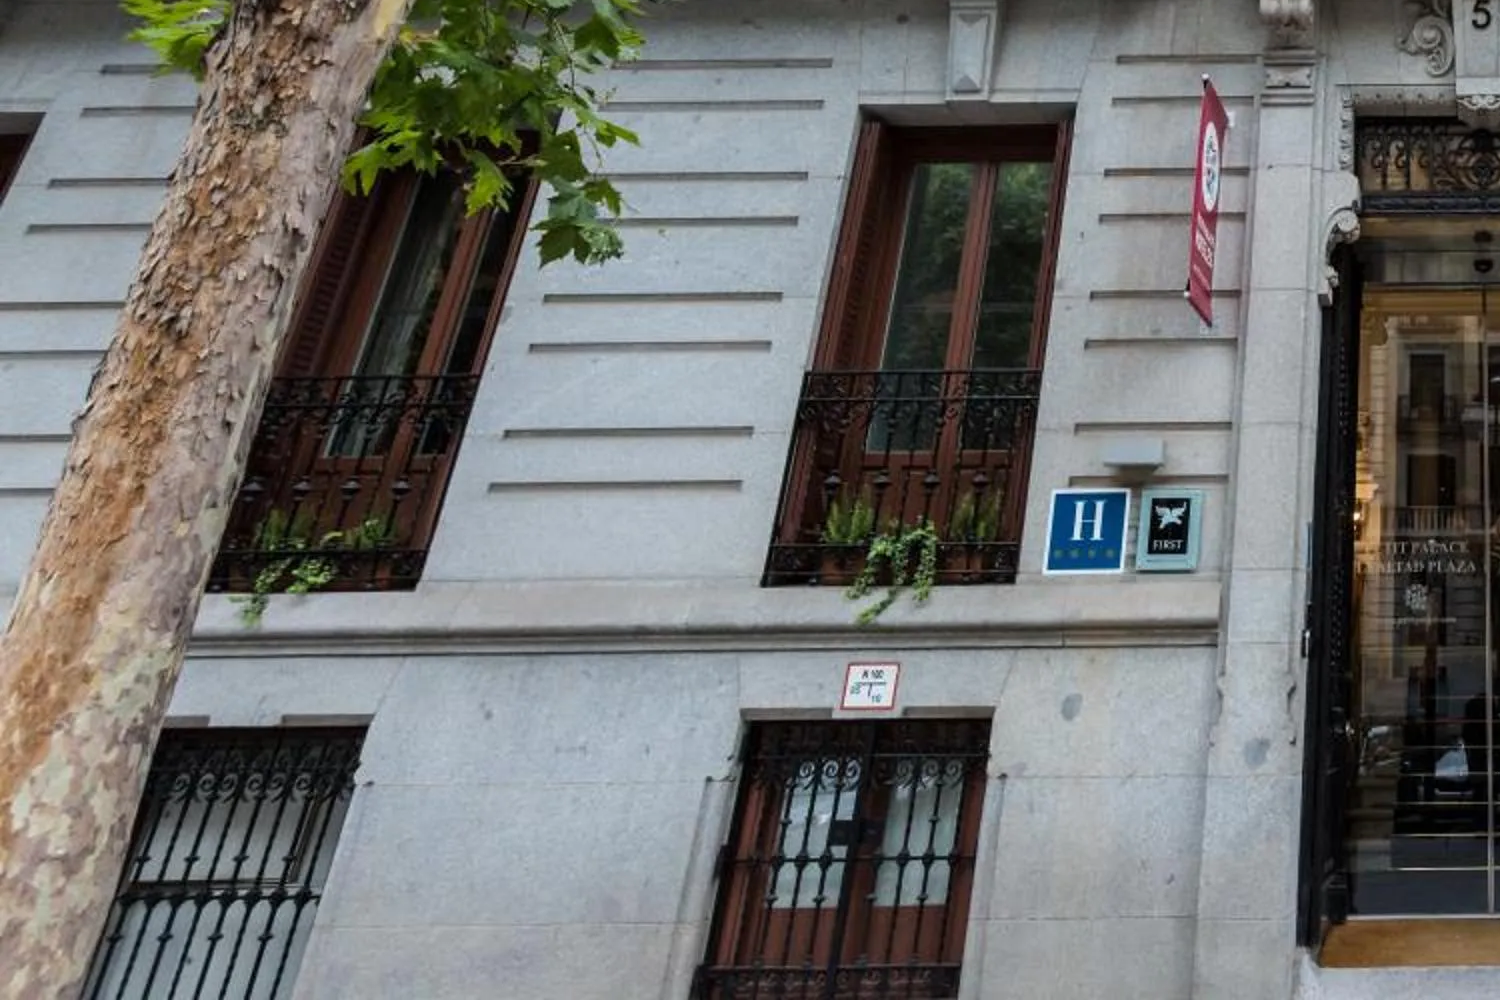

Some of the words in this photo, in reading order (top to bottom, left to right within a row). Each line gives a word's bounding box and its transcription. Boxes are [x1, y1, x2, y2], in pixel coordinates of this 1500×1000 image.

[1472, 0, 1491, 30] 5
[1070, 500, 1107, 541] H
[1152, 539, 1184, 551] FIRST
[1427, 560, 1477, 573] PLAZA
